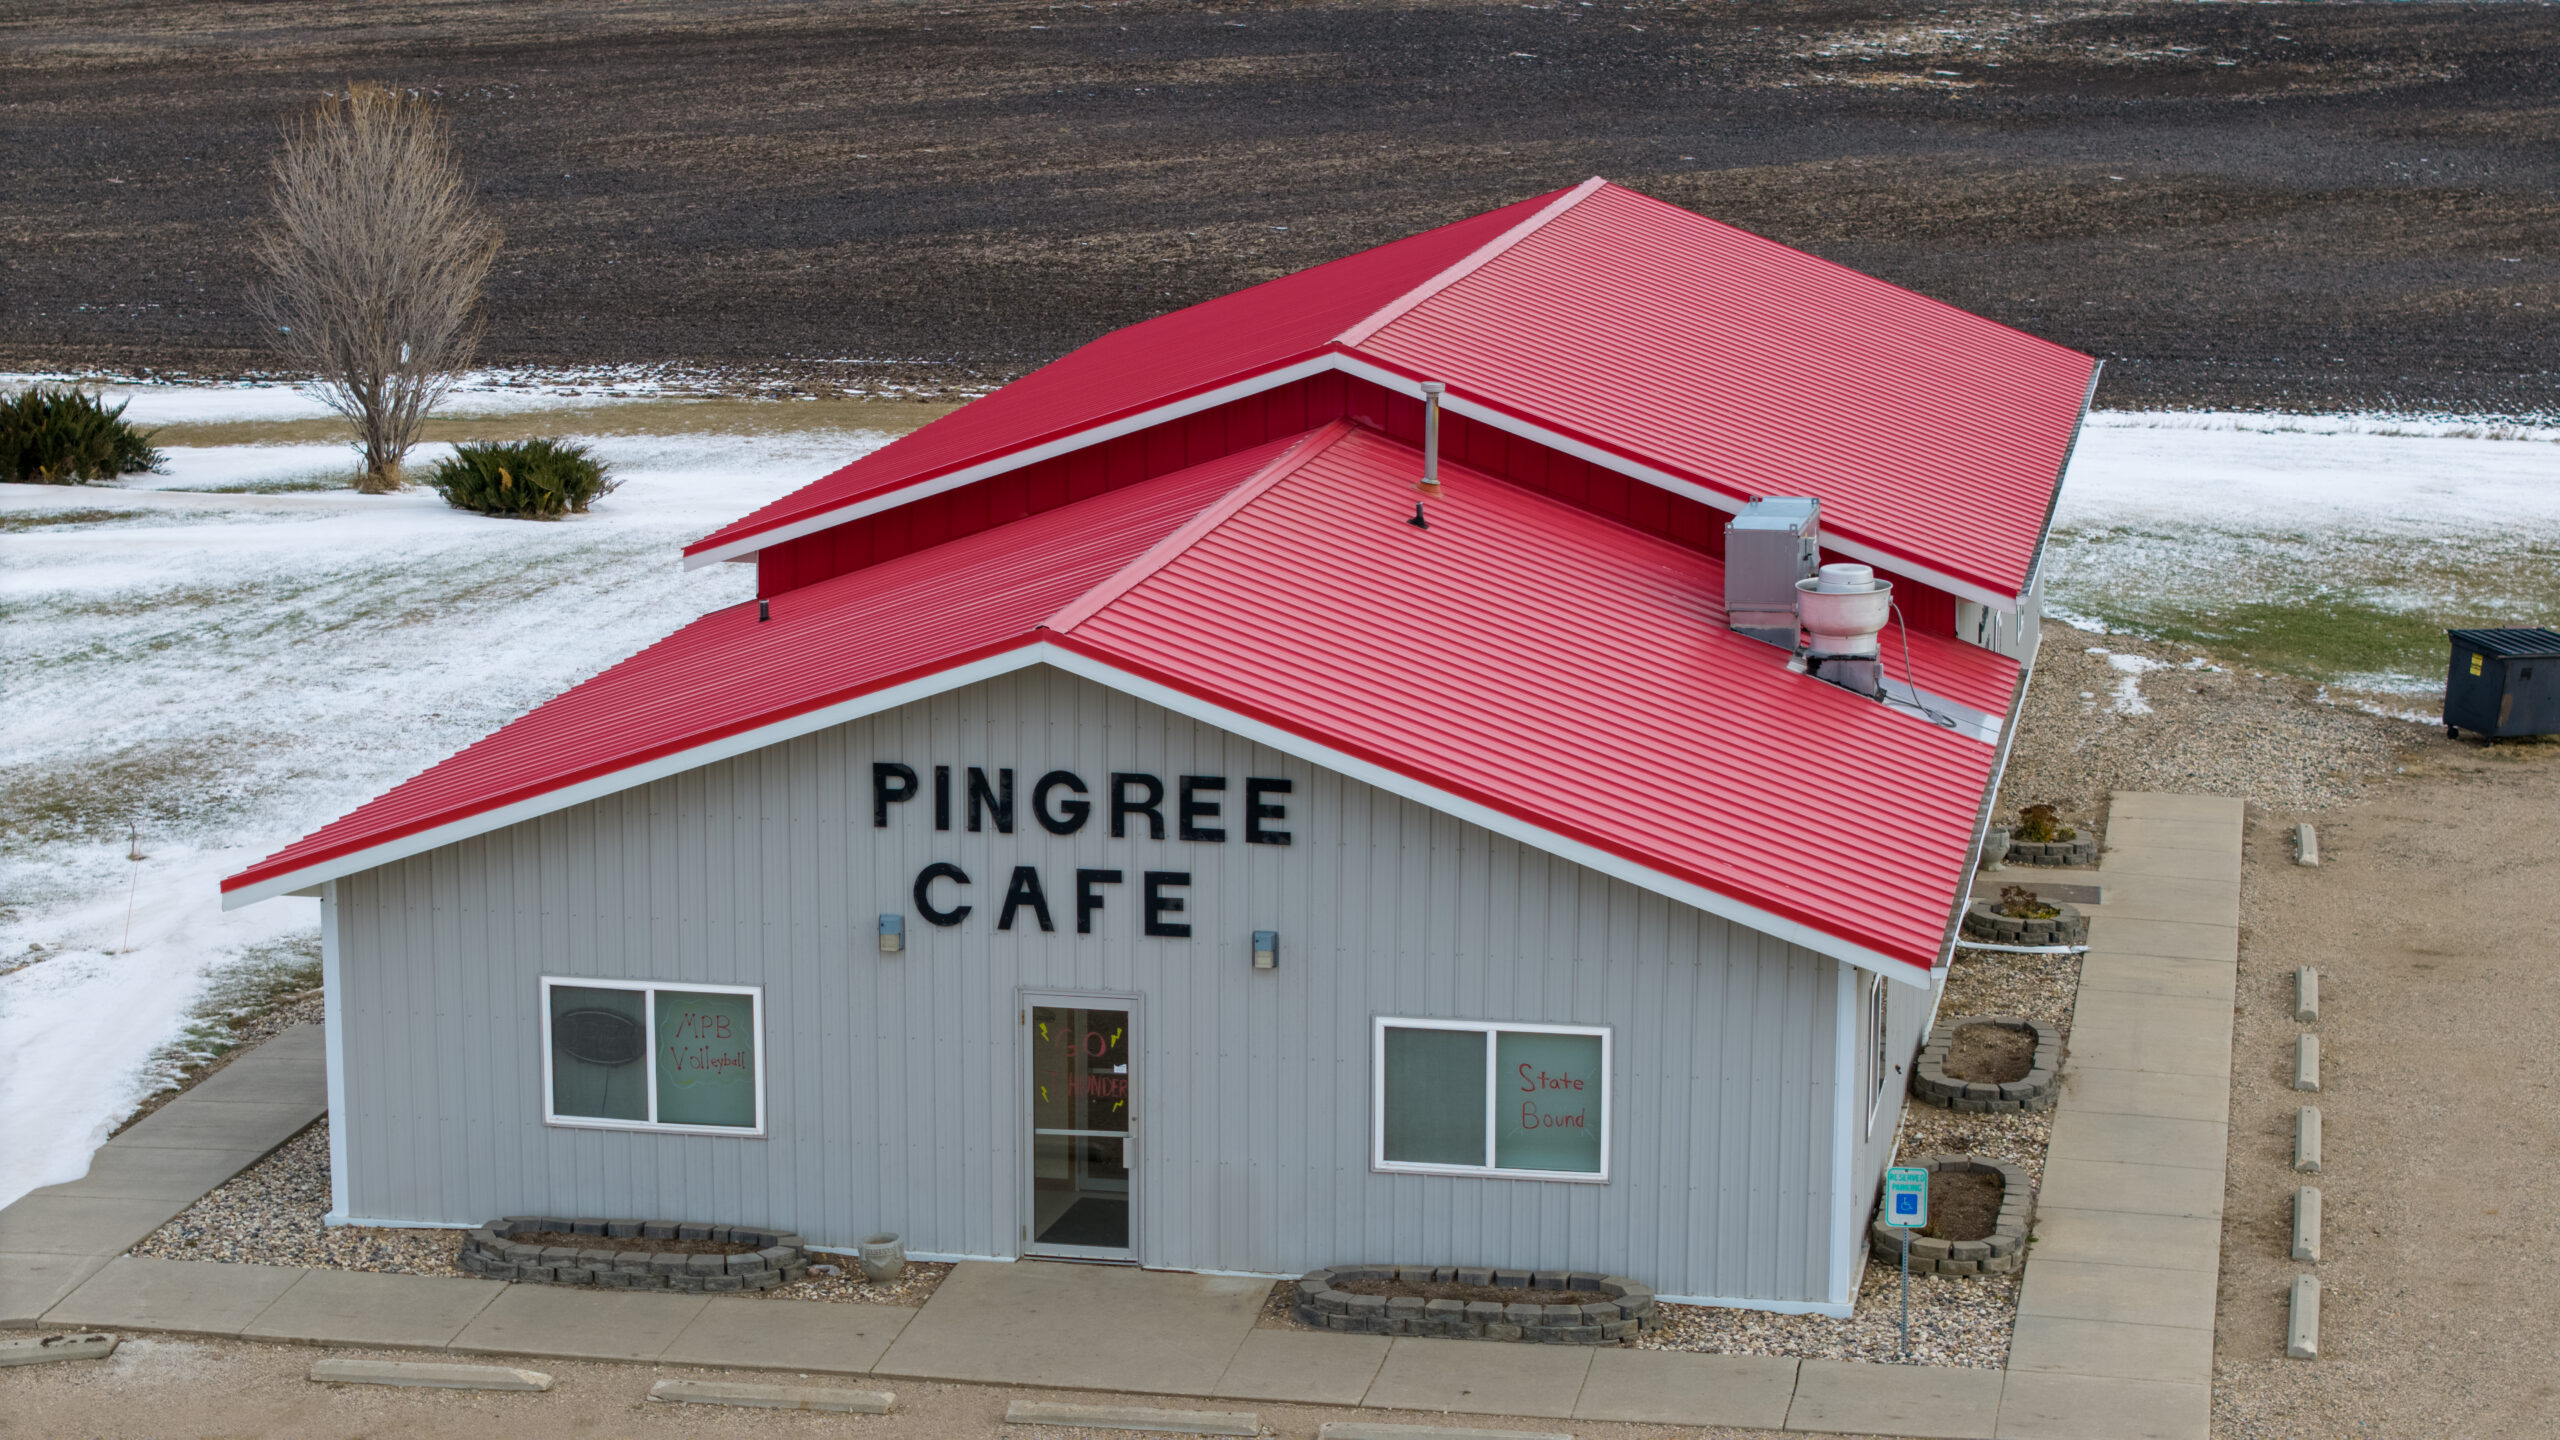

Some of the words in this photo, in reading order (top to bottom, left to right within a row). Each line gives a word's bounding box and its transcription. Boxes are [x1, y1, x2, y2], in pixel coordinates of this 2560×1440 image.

[873, 762, 1292, 845] PINGREE
[913, 862, 1191, 938] CAFE
[676, 1012, 732, 1039] MPB
[1054, 1028, 1106, 1057] GO
[670, 1046, 745, 1074] Volleyball
[1045, 1070, 1128, 1098] THUNDER
[1519, 1063, 1584, 1092] State
[1522, 1101, 1585, 1129] Bound
[1890, 1174, 1925, 1182] RESERVED
[1892, 1184, 1922, 1192] PARKING
